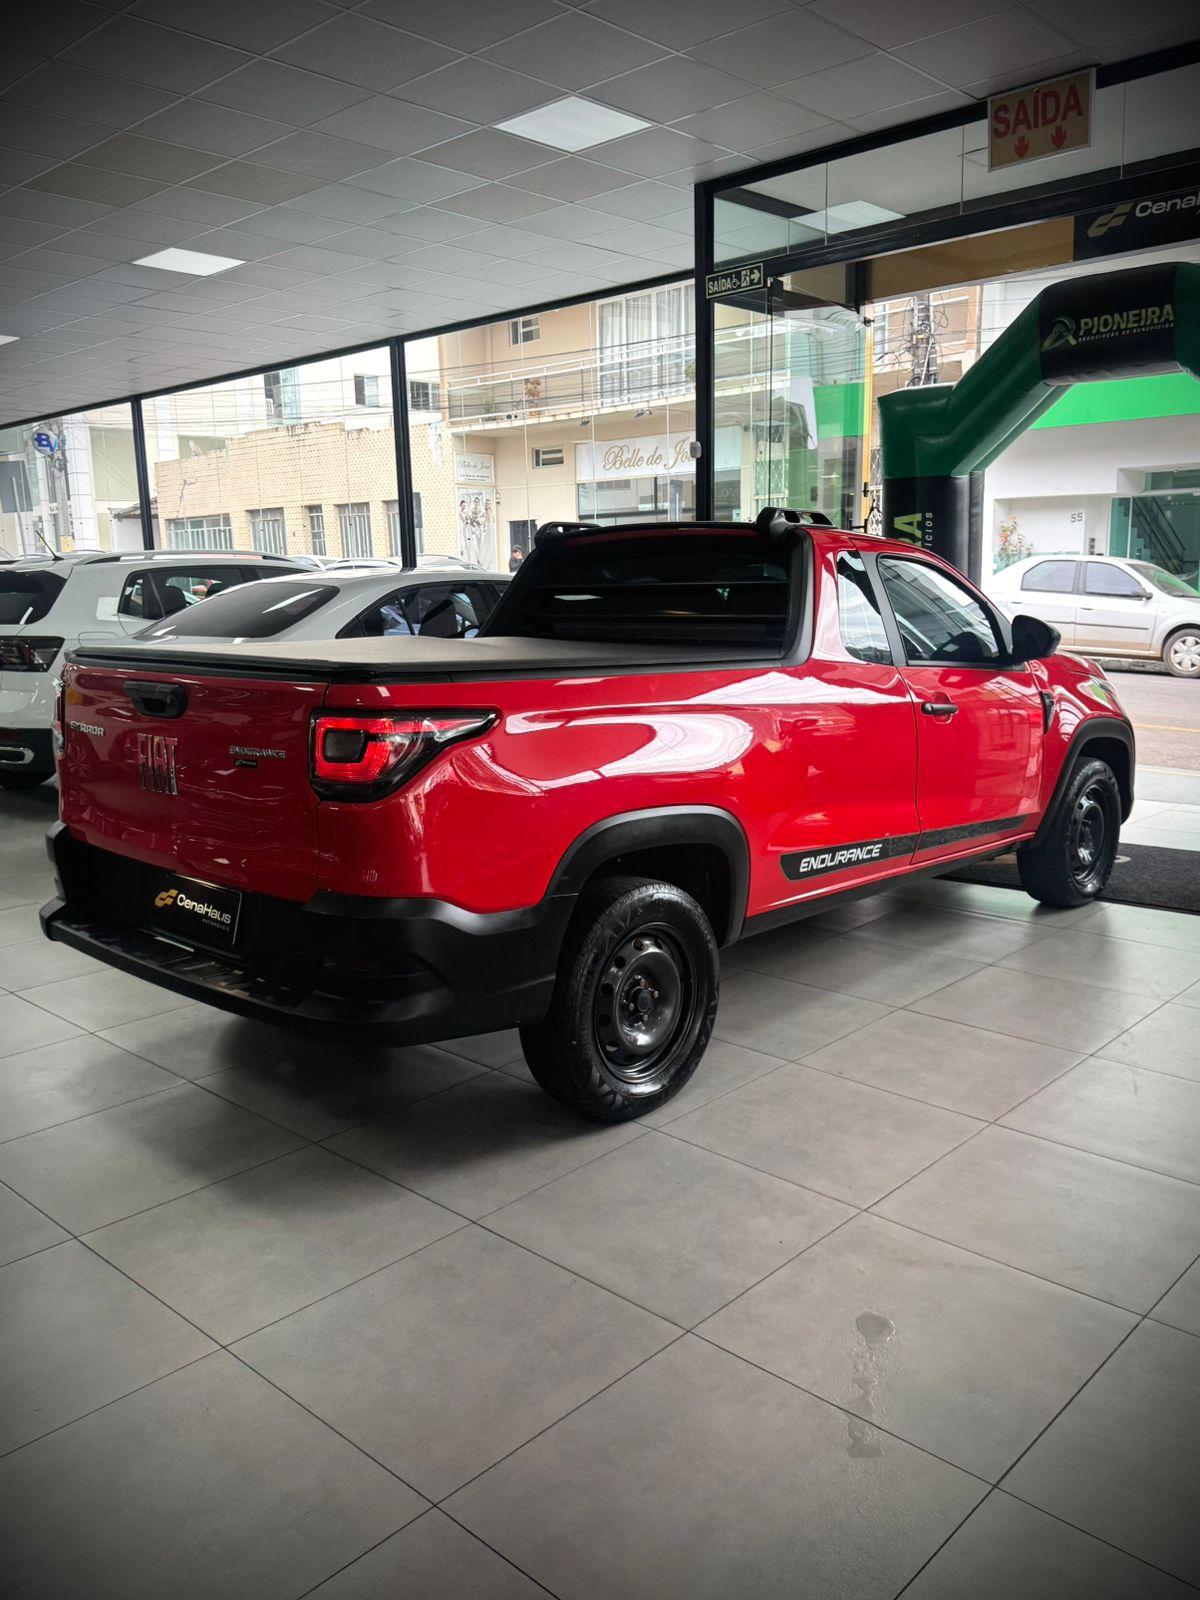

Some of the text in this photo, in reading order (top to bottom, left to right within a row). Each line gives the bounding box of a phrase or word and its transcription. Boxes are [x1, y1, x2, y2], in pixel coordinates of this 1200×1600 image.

[993, 84, 1084, 138] SAÍDA
[708, 276, 732, 293] SAÍDA
[1079, 304, 1174, 336] PIONEIRA
[603, 445, 644, 470] Belle
[645, 446, 662, 466] de
[70, 721, 105, 737] STRADA
[136, 733, 179, 796] FIAT
[799, 843, 883, 872] ENDURANCE
[177, 893, 232, 924] CenaHaus
